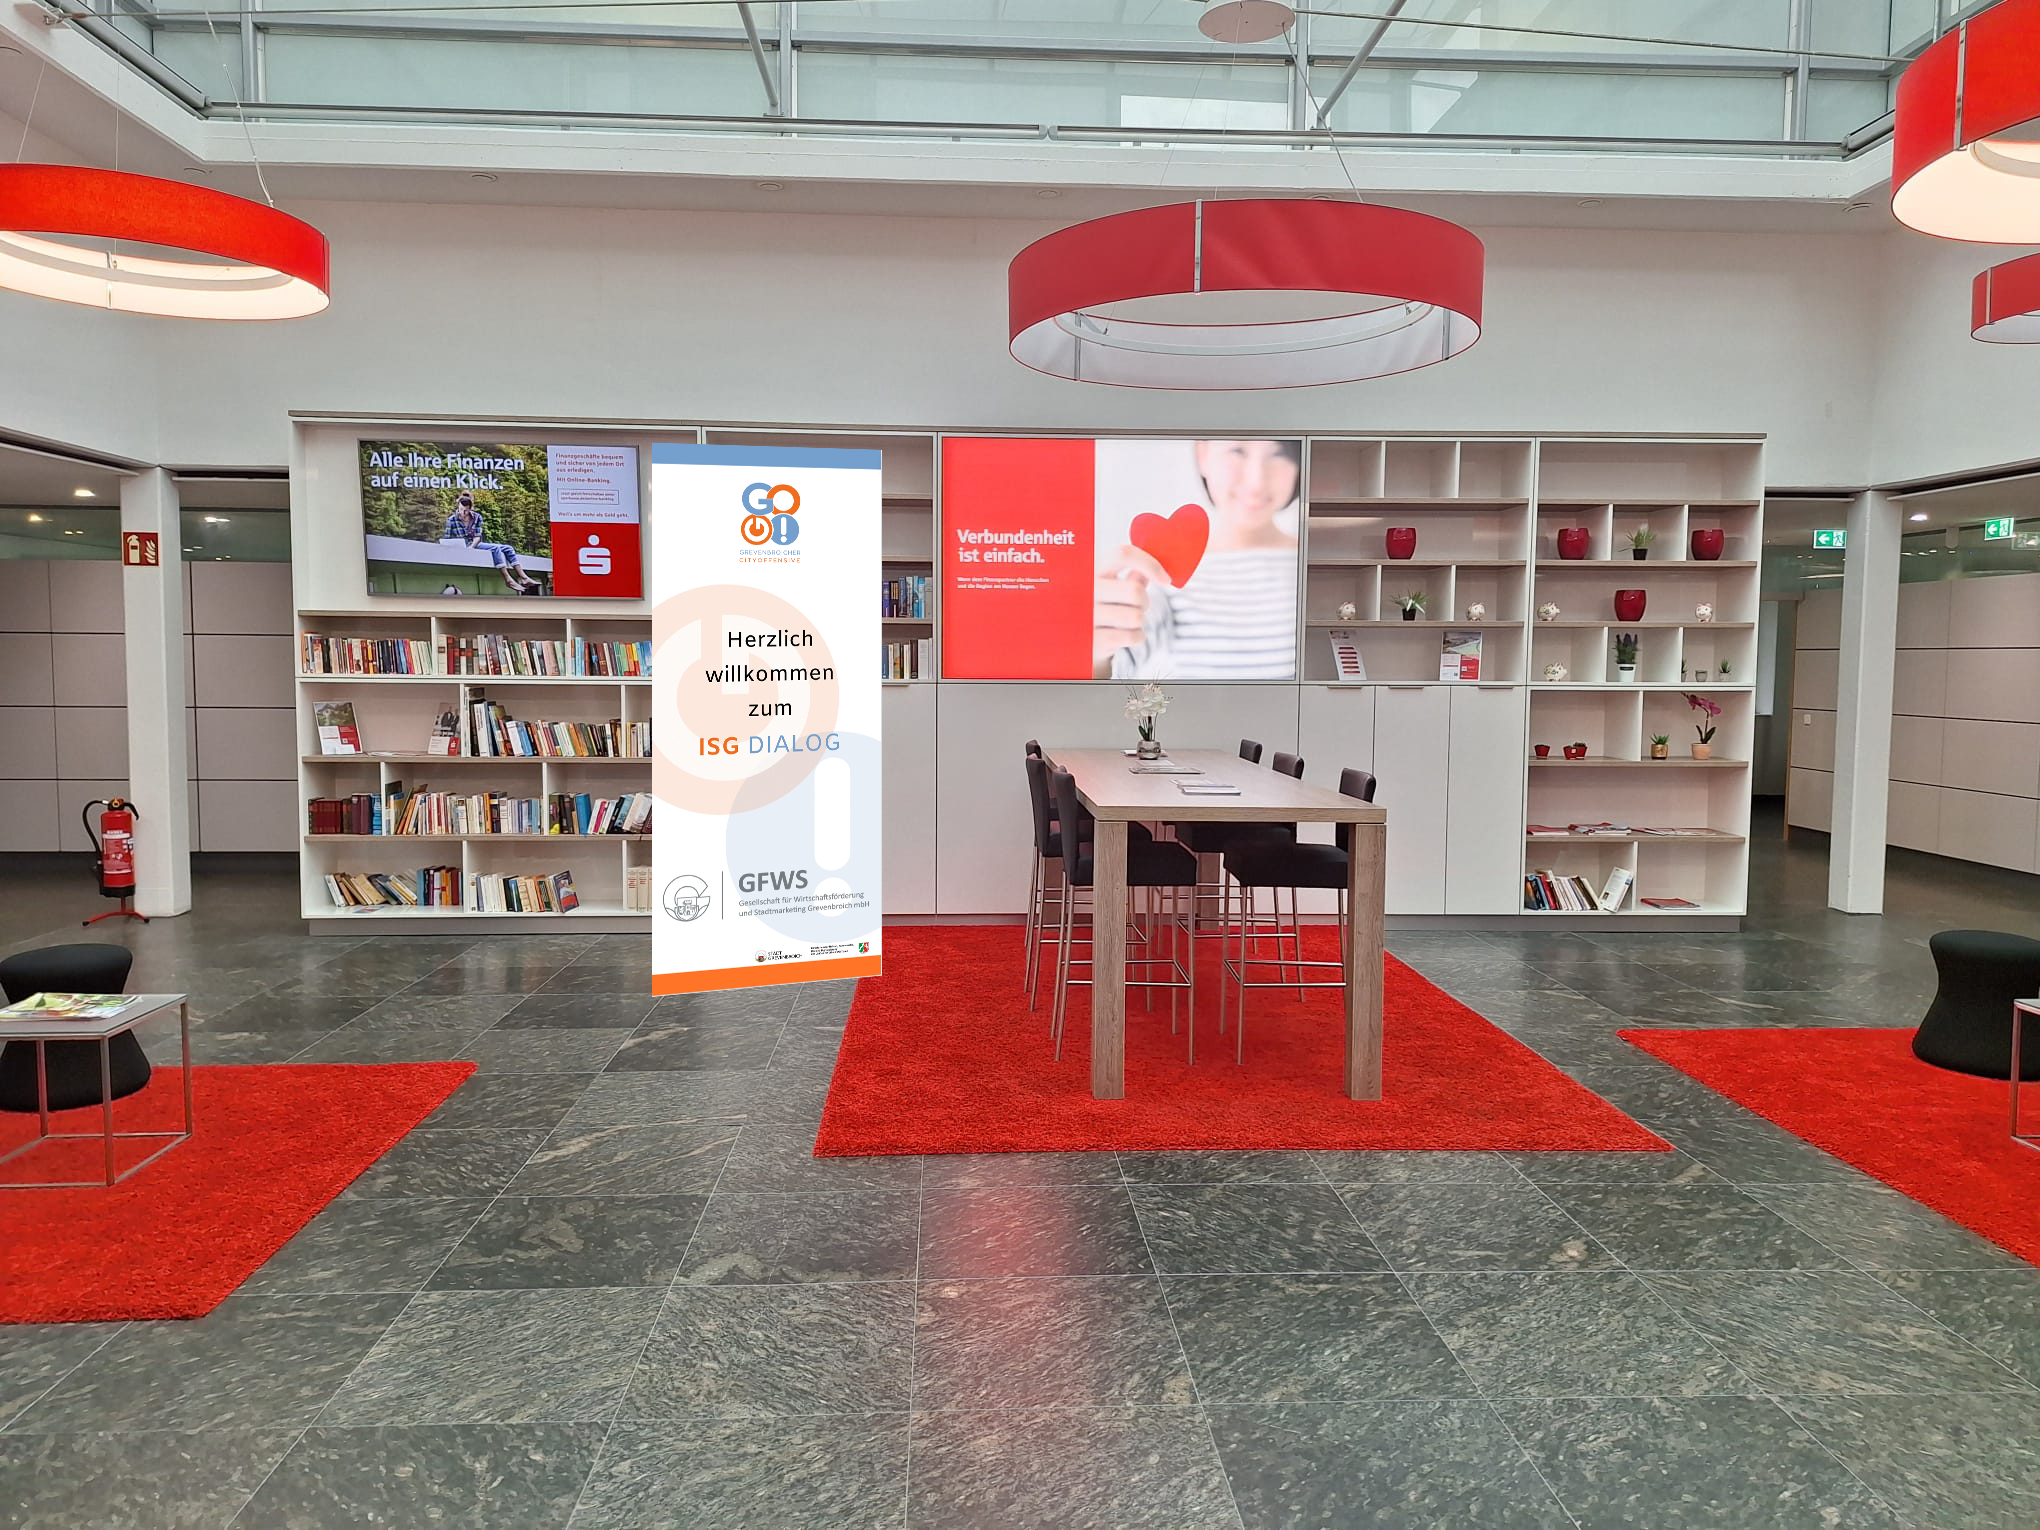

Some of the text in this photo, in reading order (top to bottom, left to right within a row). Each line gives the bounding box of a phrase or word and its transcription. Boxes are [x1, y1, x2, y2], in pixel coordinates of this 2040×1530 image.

[370, 452, 525, 471] Alle Ihre Finanzen
[371, 472, 504, 490] auf einen Klick.
[956, 529, 1075, 546] Verbundenheit
[958, 547, 1045, 563] ist einfach.
[728, 630, 813, 648] Herzlich
[705, 664, 834, 683] willkommen
[748, 701, 792, 717] zum
[699, 733, 840, 756] ISG DIALOG
[738, 869, 808, 893] GFWS
[738, 891, 864, 907] Gesellschaft für Wirtschaftsförderung
[738, 900, 870, 917] und Stadtmarketing Grevenbroich mbH
